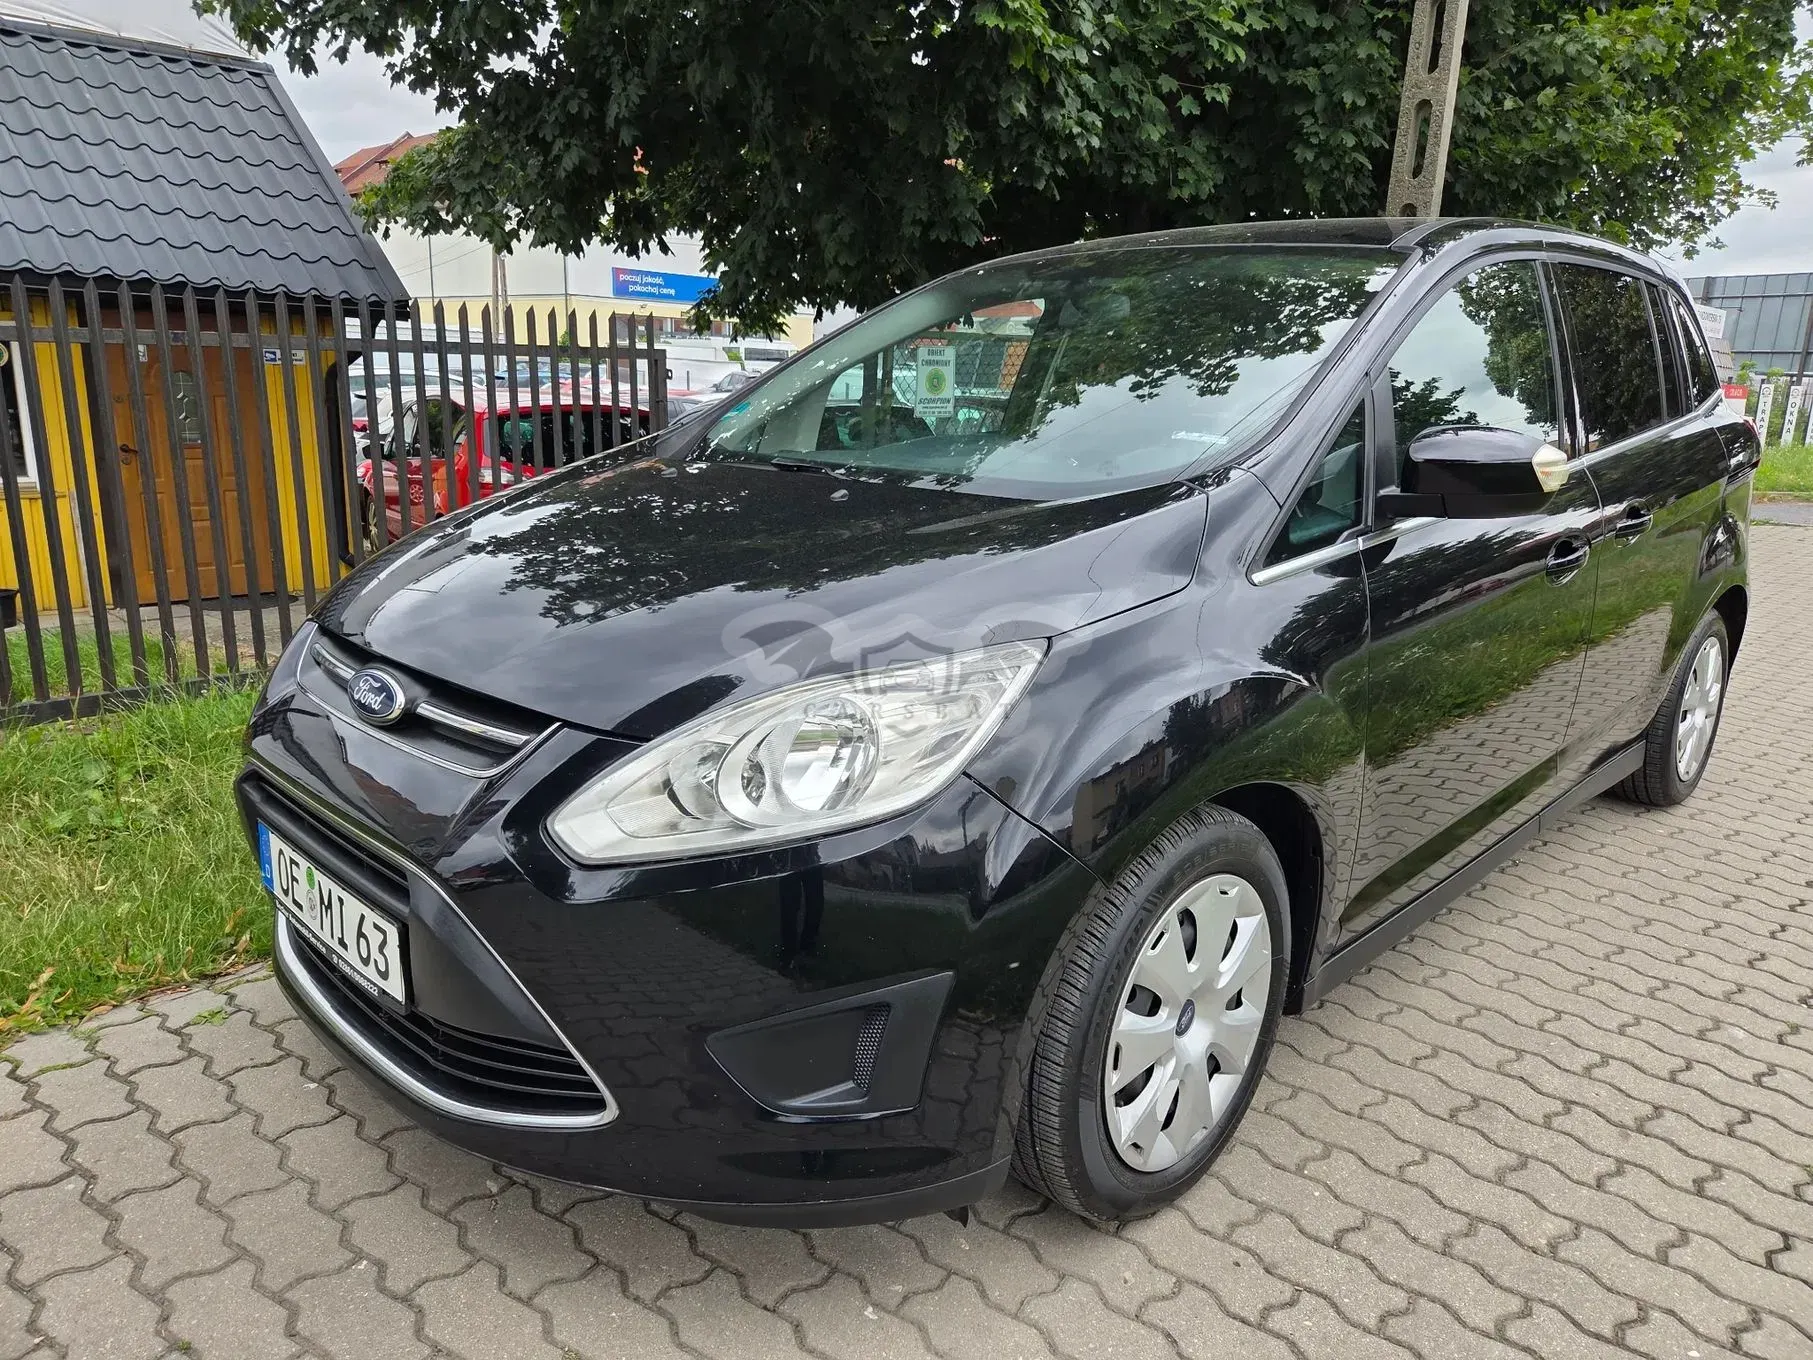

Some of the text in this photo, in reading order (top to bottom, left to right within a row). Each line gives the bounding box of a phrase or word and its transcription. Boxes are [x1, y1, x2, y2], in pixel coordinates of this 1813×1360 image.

[620, 274, 641, 283] poczuj
[629, 284, 676, 297] pokochaj cenę
[918, 397, 951, 405] SCORPION
[1785, 401, 1797, 434] OKNA
[353, 676, 386, 710] Ford
[277, 847, 304, 912] OE
[317, 879, 349, 953] MI
[356, 912, 390, 982] 63
